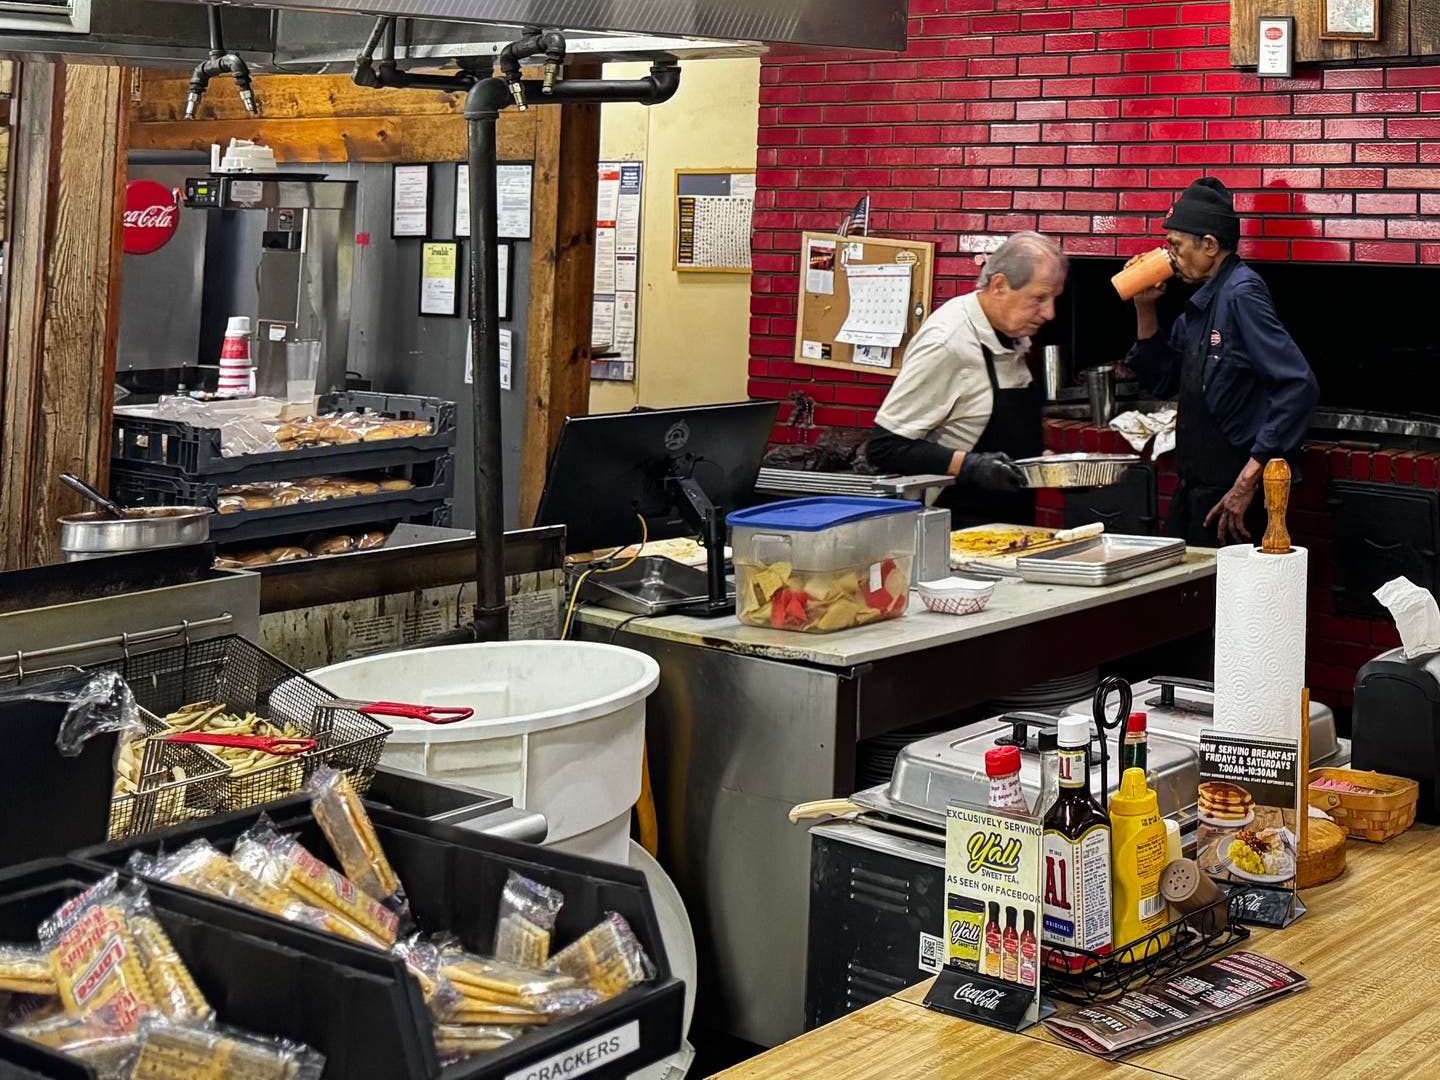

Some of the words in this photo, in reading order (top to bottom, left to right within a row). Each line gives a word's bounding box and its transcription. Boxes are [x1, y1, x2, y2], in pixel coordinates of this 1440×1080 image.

[1200, 743, 1216, 752] NOW
[1218, 745, 1249, 756] SERVING
[1251, 748, 1296, 761] BREAKFAST
[1205, 753, 1236, 764] FRIDAYS
[1238, 757, 1244, 765] &
[1246, 758, 1291, 770] SATURDAYS
[1218, 764, 1278, 778] 7:00AM-10:30AM
[946, 809, 1002, 828] EXCLUSIVELY
[1004, 821, 1042, 837] SERVING
[967, 831, 1022, 873] Y'all
[981, 869, 1002, 880] SWEET
[947, 875, 957, 884] AS
[960, 877, 980, 889] SEEN
[981, 883, 994, 893] ON
[995, 886, 1041, 904] FACEBOOK
[60, 919, 120, 970] Captain's
[951, 920, 981, 944] Y'all
[76, 943, 123, 999] Lance
[953, 982, 1007, 1009] Coca-Cola
[526, 1036, 620, 1080] CRACKERS
